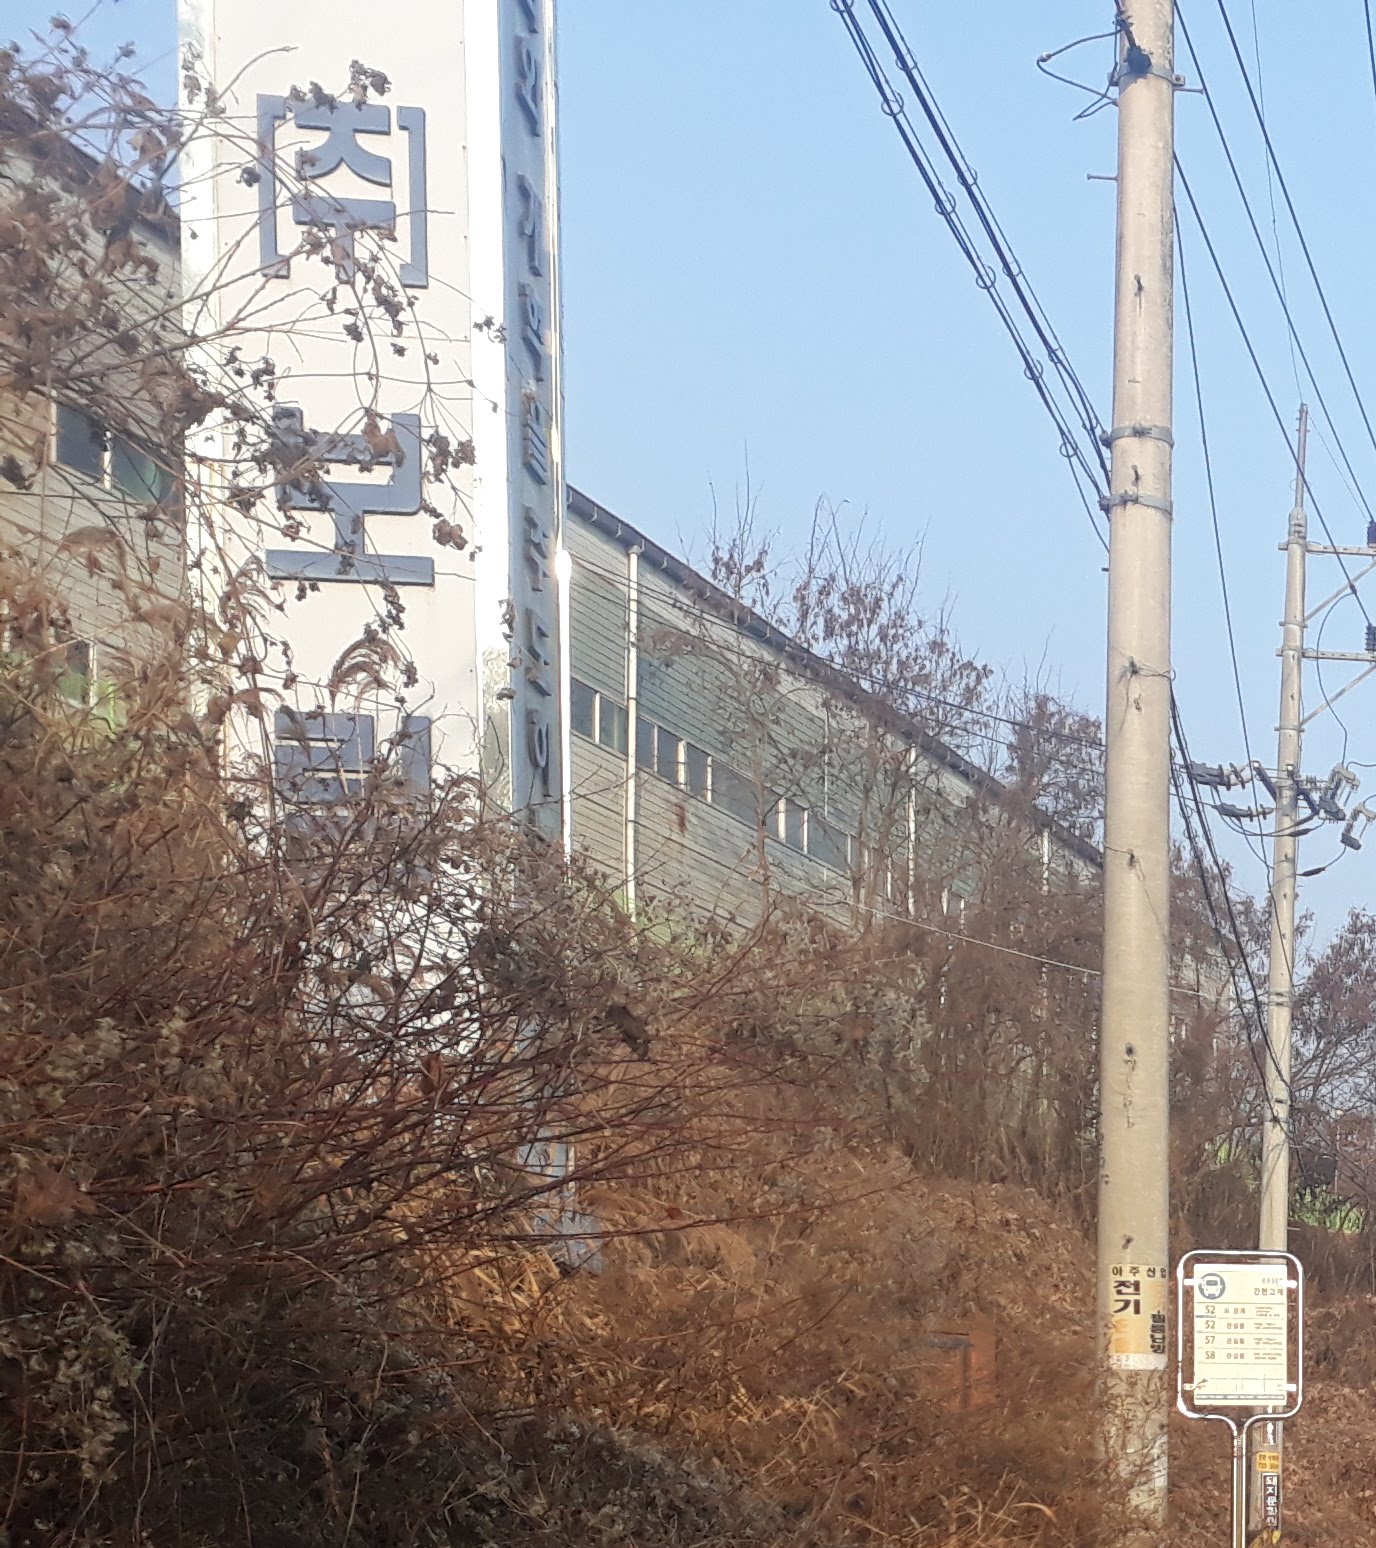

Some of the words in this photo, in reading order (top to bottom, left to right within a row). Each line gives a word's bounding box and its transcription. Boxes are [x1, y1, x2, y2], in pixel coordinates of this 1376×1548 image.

[1113, 1280, 1141, 1315] 전기
[1205, 1305, 1216, 1314] 52
[1205, 1320, 1216, 1329] 52
[1205, 1335, 1216, 1345] 57
[1205, 1351, 1216, 1360] 58
